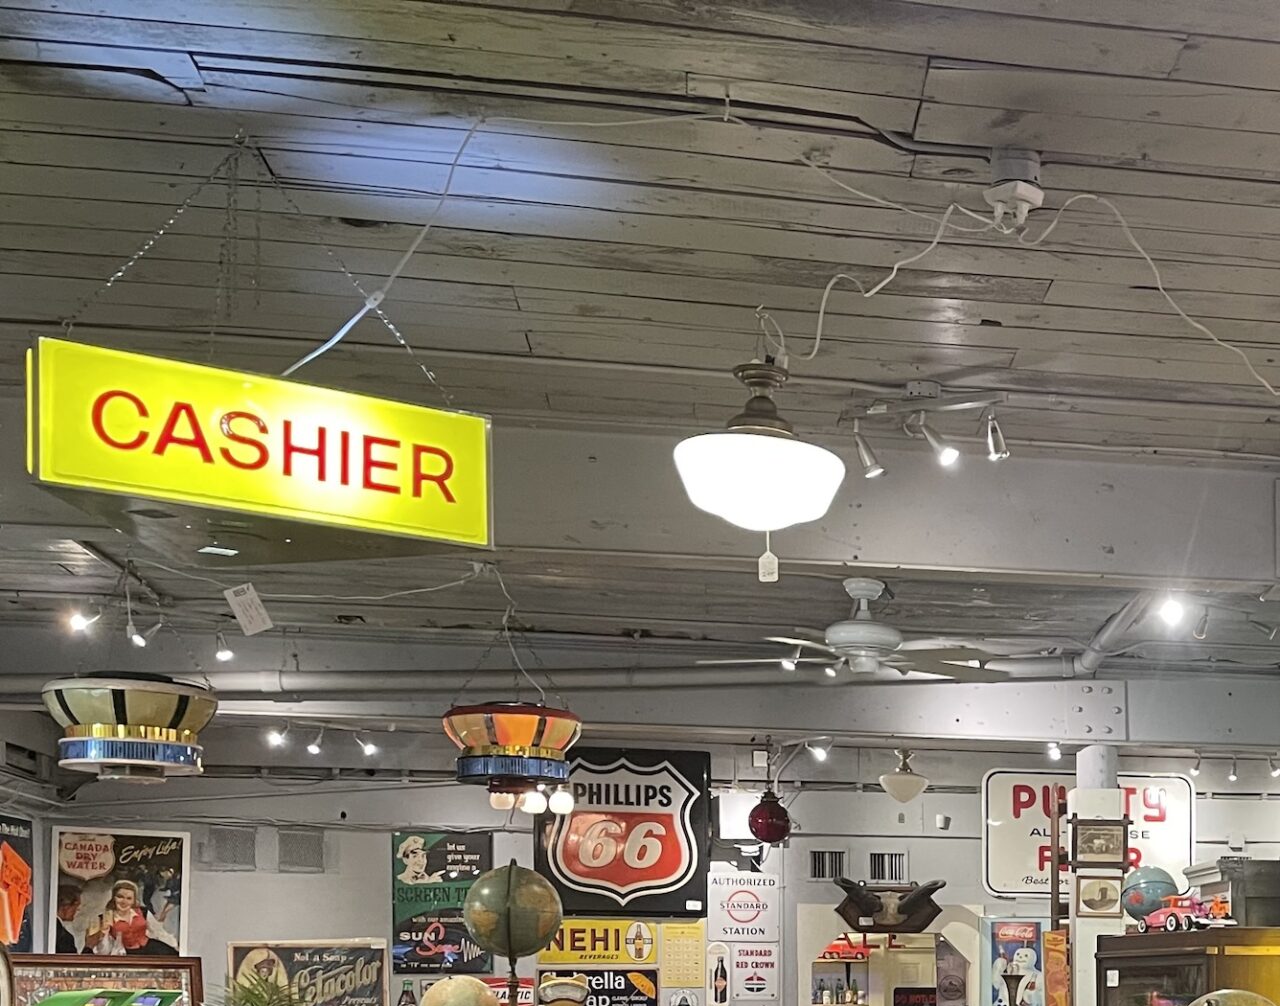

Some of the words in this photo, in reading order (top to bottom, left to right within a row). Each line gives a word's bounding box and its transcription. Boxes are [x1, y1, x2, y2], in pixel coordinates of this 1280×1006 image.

[91, 389, 457, 503] CASHIER
[573, 782, 673, 808] PHILLIPS
[64, 842, 110, 853] CANADA
[577, 820, 668, 869] 66
[75, 851, 98, 862] DRY
[119, 844, 153, 864] Enjoy
[66, 861, 106, 871] WATER
[711, 877, 776, 887] AUTHORIZED
[1021, 875, 1049, 885] Best
[396, 886, 452, 903] SCREEN
[720, 902, 769, 910] STANDARD
[399, 931, 435, 941] SUN
[722, 927, 766, 936] STATION
[999, 926, 1034, 939] Coca-Cola
[545, 928, 620, 951] NEHI
[293, 952, 309, 962] Not
[312, 954, 320, 962] a
[738, 949, 772, 957] STANDARD
[736, 961, 749, 969] RED
[751, 961, 775, 969] CROWN
